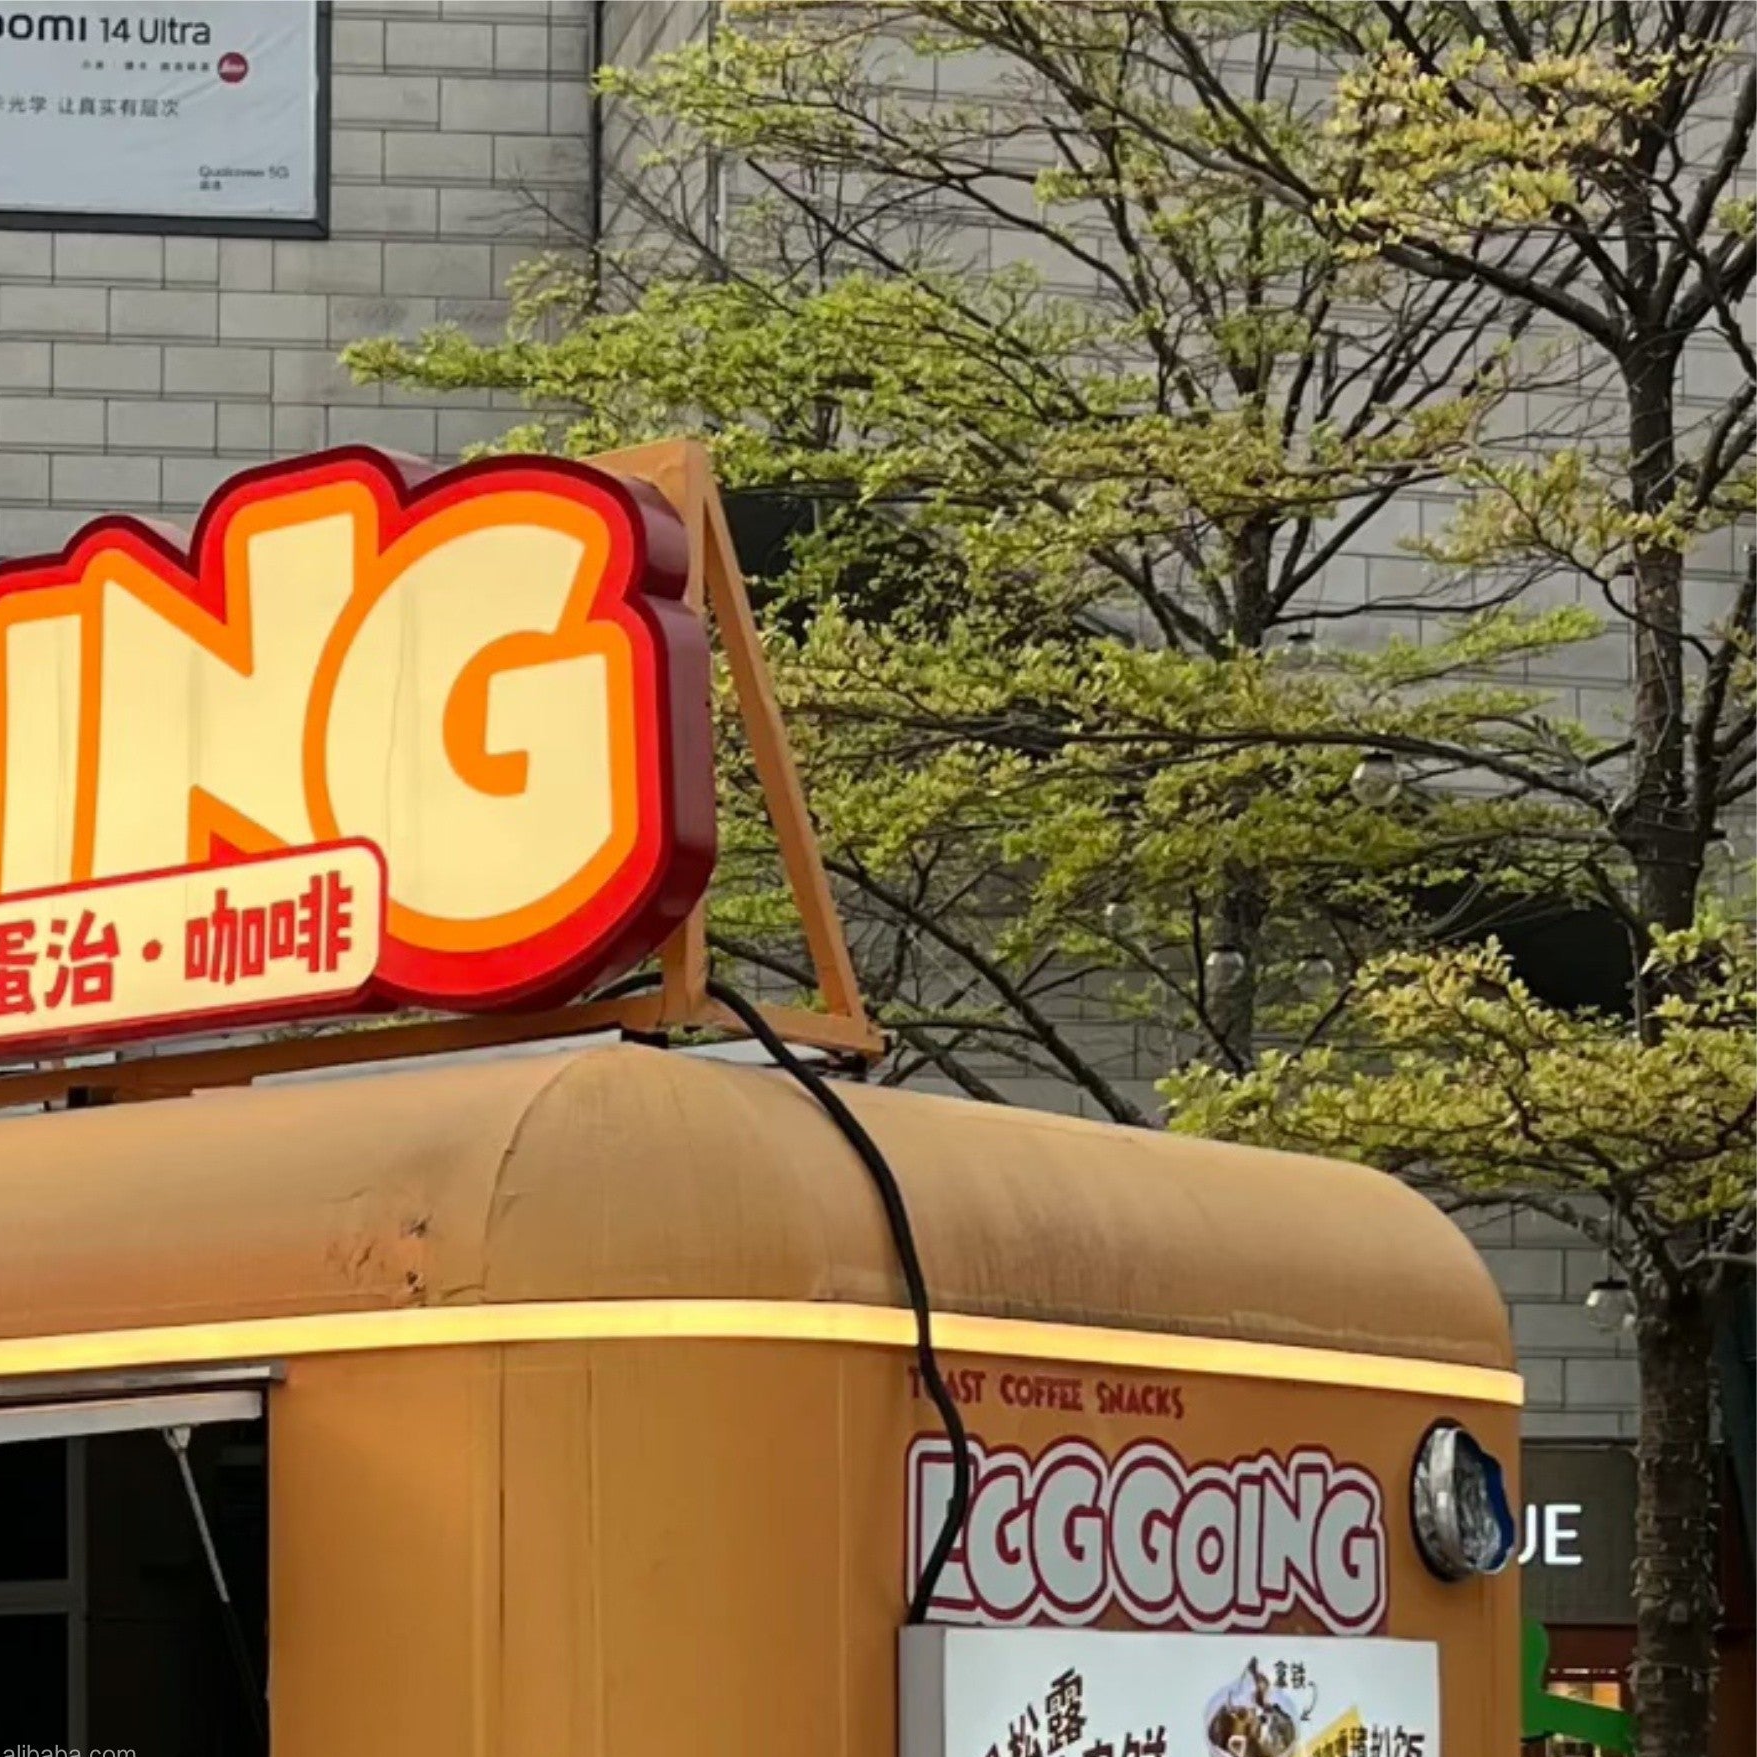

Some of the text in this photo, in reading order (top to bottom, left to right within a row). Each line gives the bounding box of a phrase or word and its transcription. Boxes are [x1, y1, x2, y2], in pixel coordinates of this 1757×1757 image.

[99, 17, 131, 44] 14
[139, 17, 211, 46] Ultra
[1000, 1373, 1083, 1411] COFFEE
[1096, 1381, 1185, 1420] SNACKS
